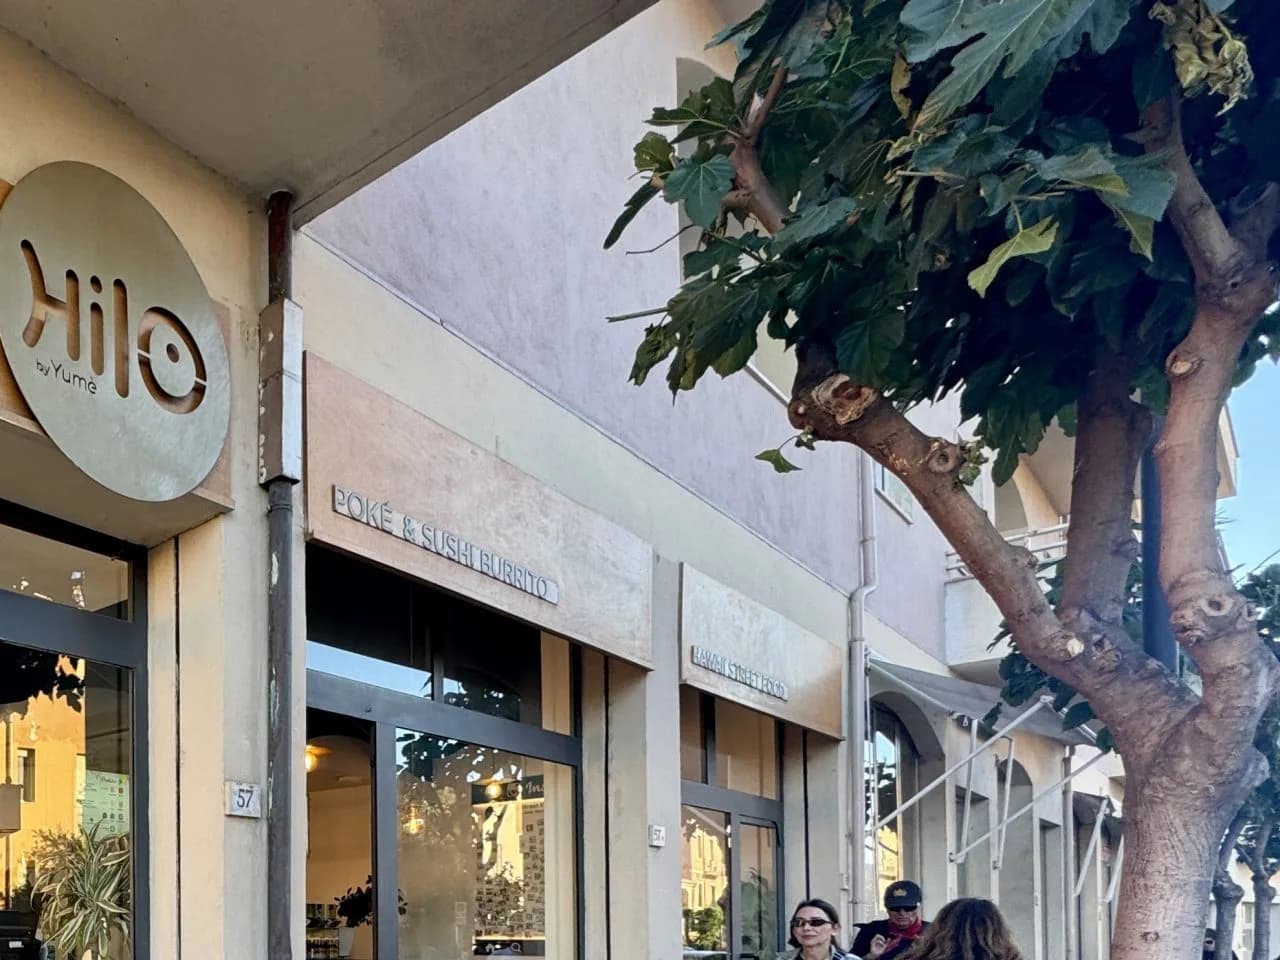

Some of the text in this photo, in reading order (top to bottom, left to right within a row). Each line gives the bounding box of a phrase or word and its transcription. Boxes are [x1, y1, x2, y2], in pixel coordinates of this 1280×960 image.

[20, 239, 208, 415] Hilo
[36, 357, 98, 395] by Yumè
[333, 485, 549, 599] POKÉ & SUSHI BURRITO
[692, 646, 785, 699] HAWAII STREET FOOD
[236, 788, 254, 808] 57
